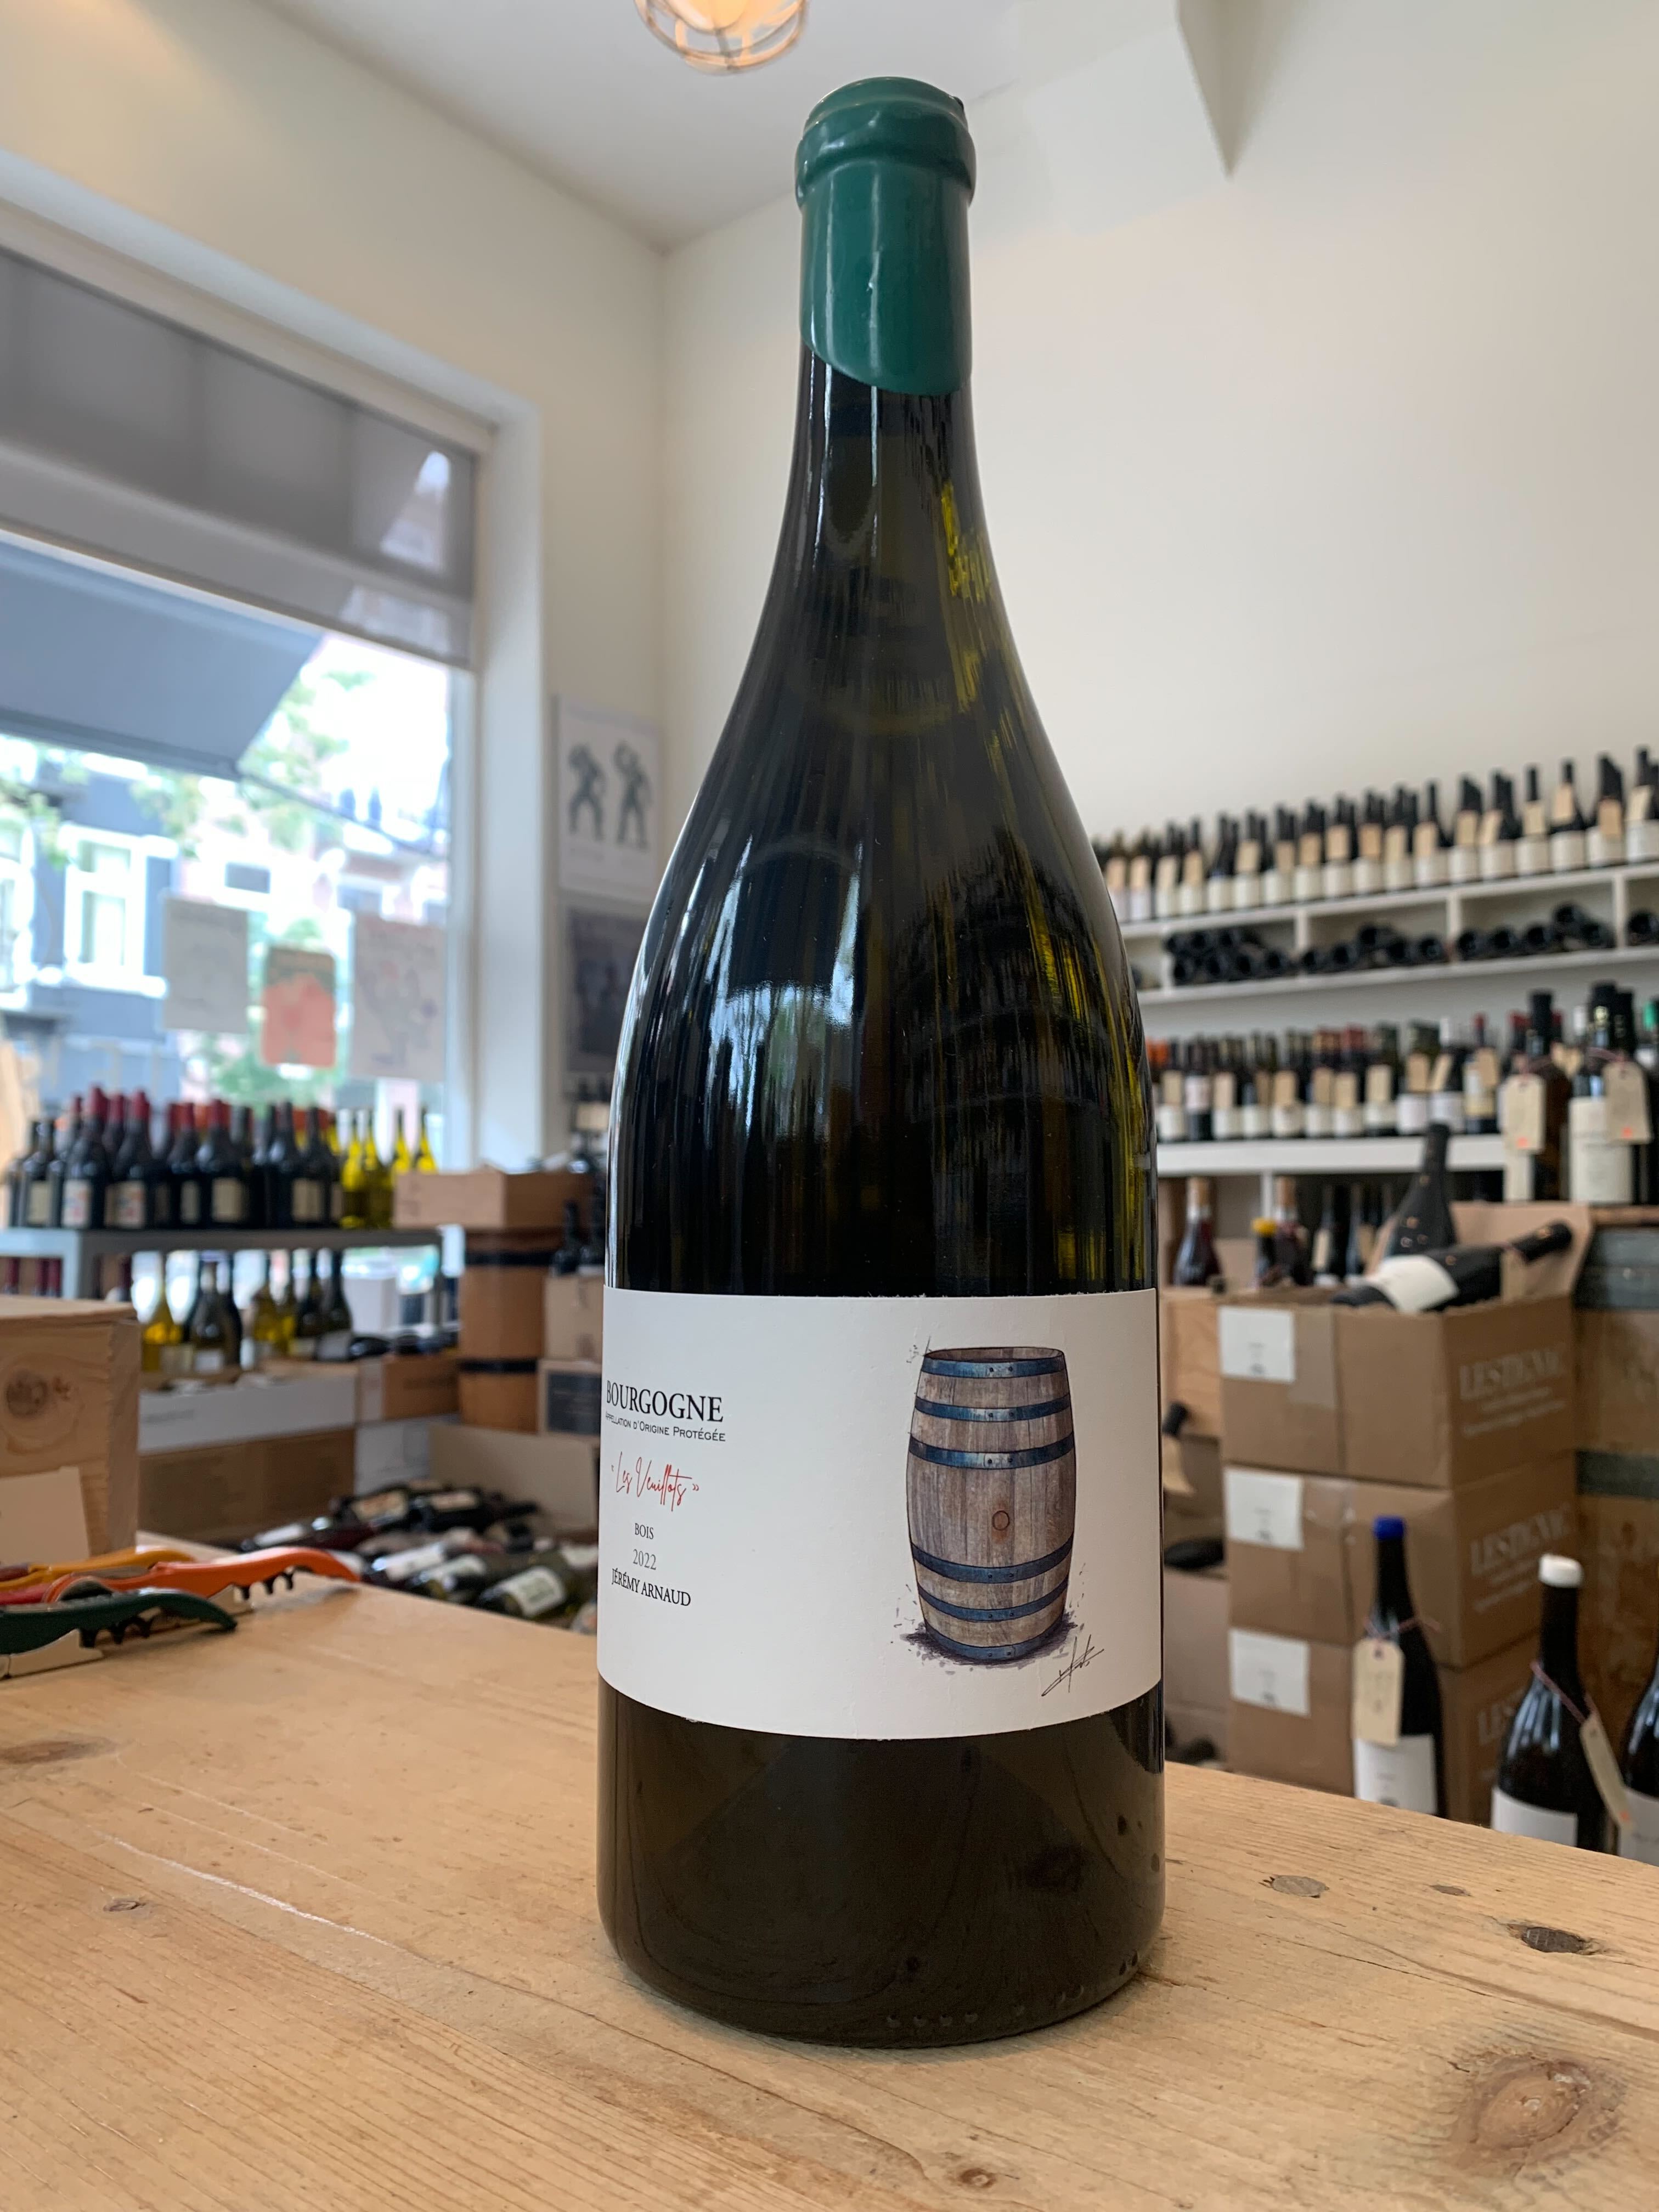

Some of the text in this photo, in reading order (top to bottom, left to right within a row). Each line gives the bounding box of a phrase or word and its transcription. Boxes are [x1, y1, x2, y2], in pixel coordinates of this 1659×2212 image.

[606, 1380, 724, 1422] BOURGOGNE
[673, 1426, 726, 1442] PROTÉGÉE
[635, 1522, 654, 1540] BOIS
[633, 1549, 657, 1570] 2022
[611, 1567, 691, 1606] JÉRÉMY ARNAUD
